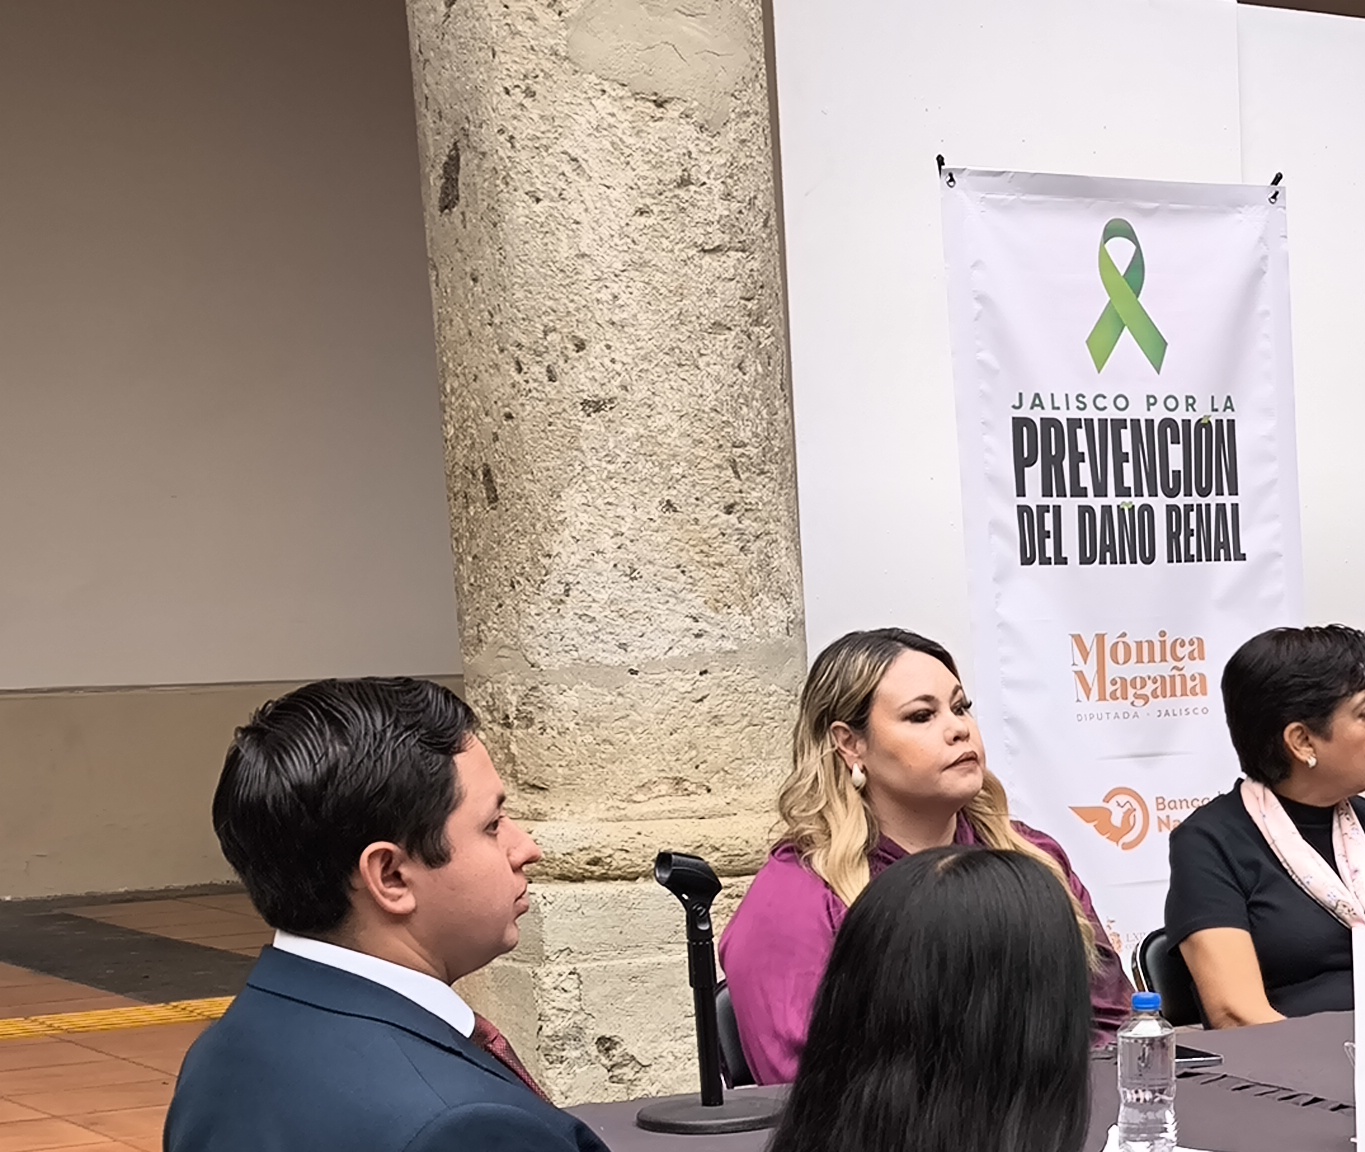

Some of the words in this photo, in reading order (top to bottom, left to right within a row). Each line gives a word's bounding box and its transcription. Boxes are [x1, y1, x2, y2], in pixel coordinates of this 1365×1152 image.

[1011, 392, 1130, 412] JALISCO
[1147, 394, 1197, 413] POR
[1211, 394, 1236, 413] LA
[1011, 415, 1239, 498] PREVENCIÓN
[1017, 504, 1068, 566] DEL
[1078, 501, 1156, 566] DAÑO
[1166, 503, 1246, 563] RENAL
[1068, 630, 1206, 668] Mónica
[1072, 665, 1208, 707] Magaña
[1076, 711, 1140, 722] DIPUTADA
[1157, 707, 1209, 718] JALISCO
